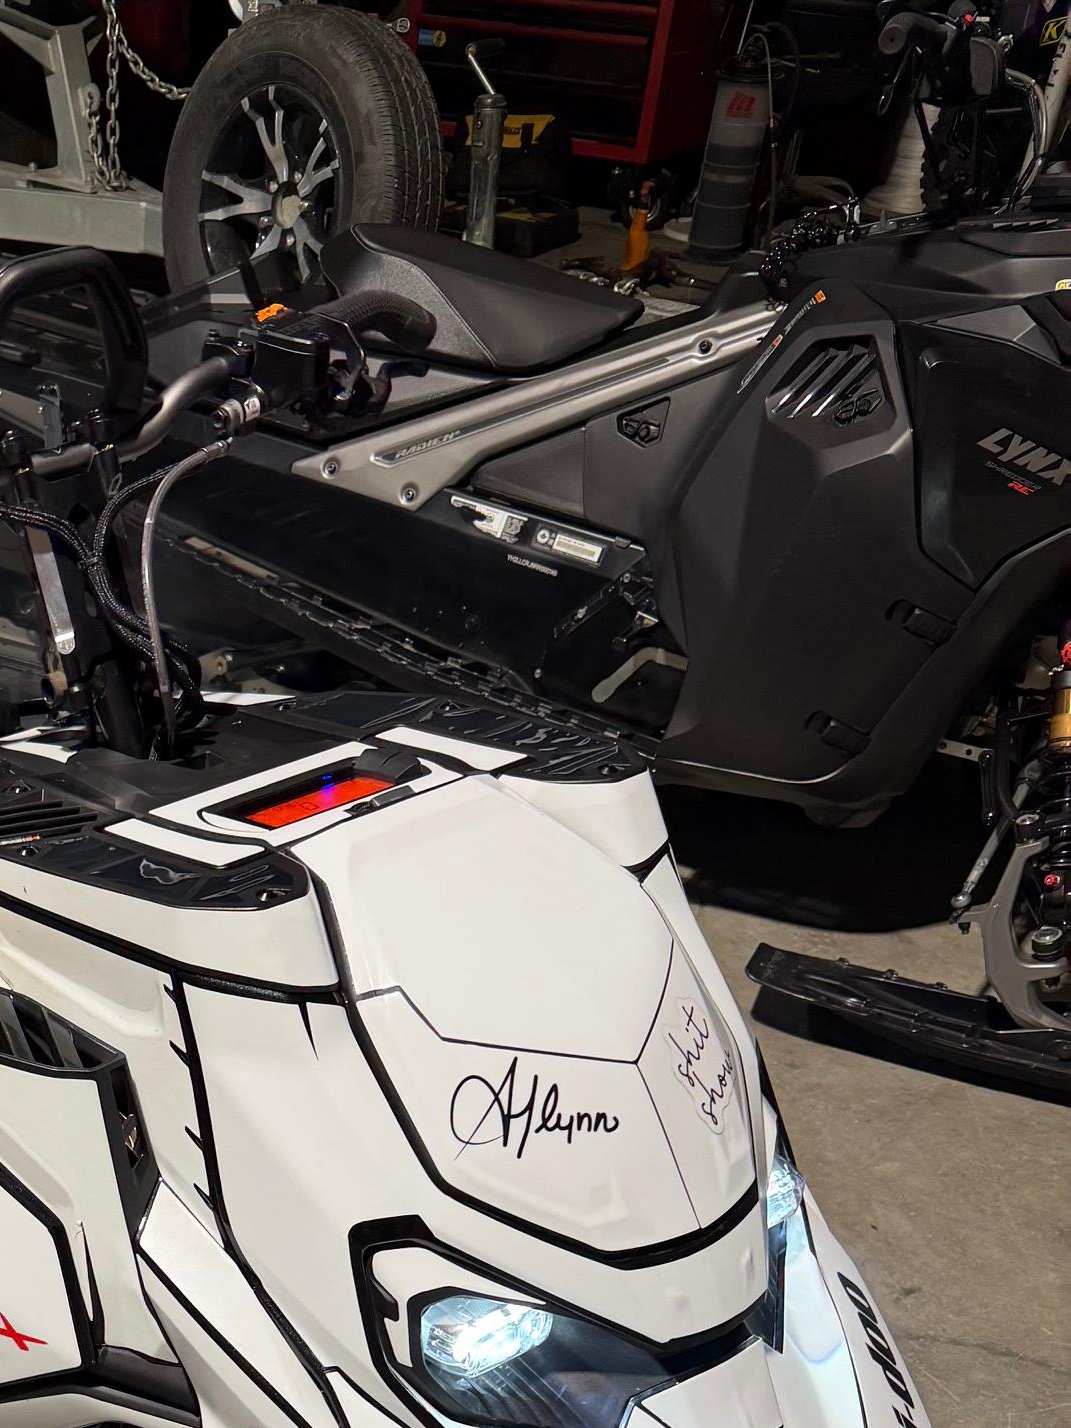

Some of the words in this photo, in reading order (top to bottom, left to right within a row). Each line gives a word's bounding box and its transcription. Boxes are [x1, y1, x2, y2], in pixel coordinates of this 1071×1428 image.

[977, 428, 1071, 486] LYNX
[668, 1005, 709, 1087] shit
[692, 1049, 733, 1126] show
